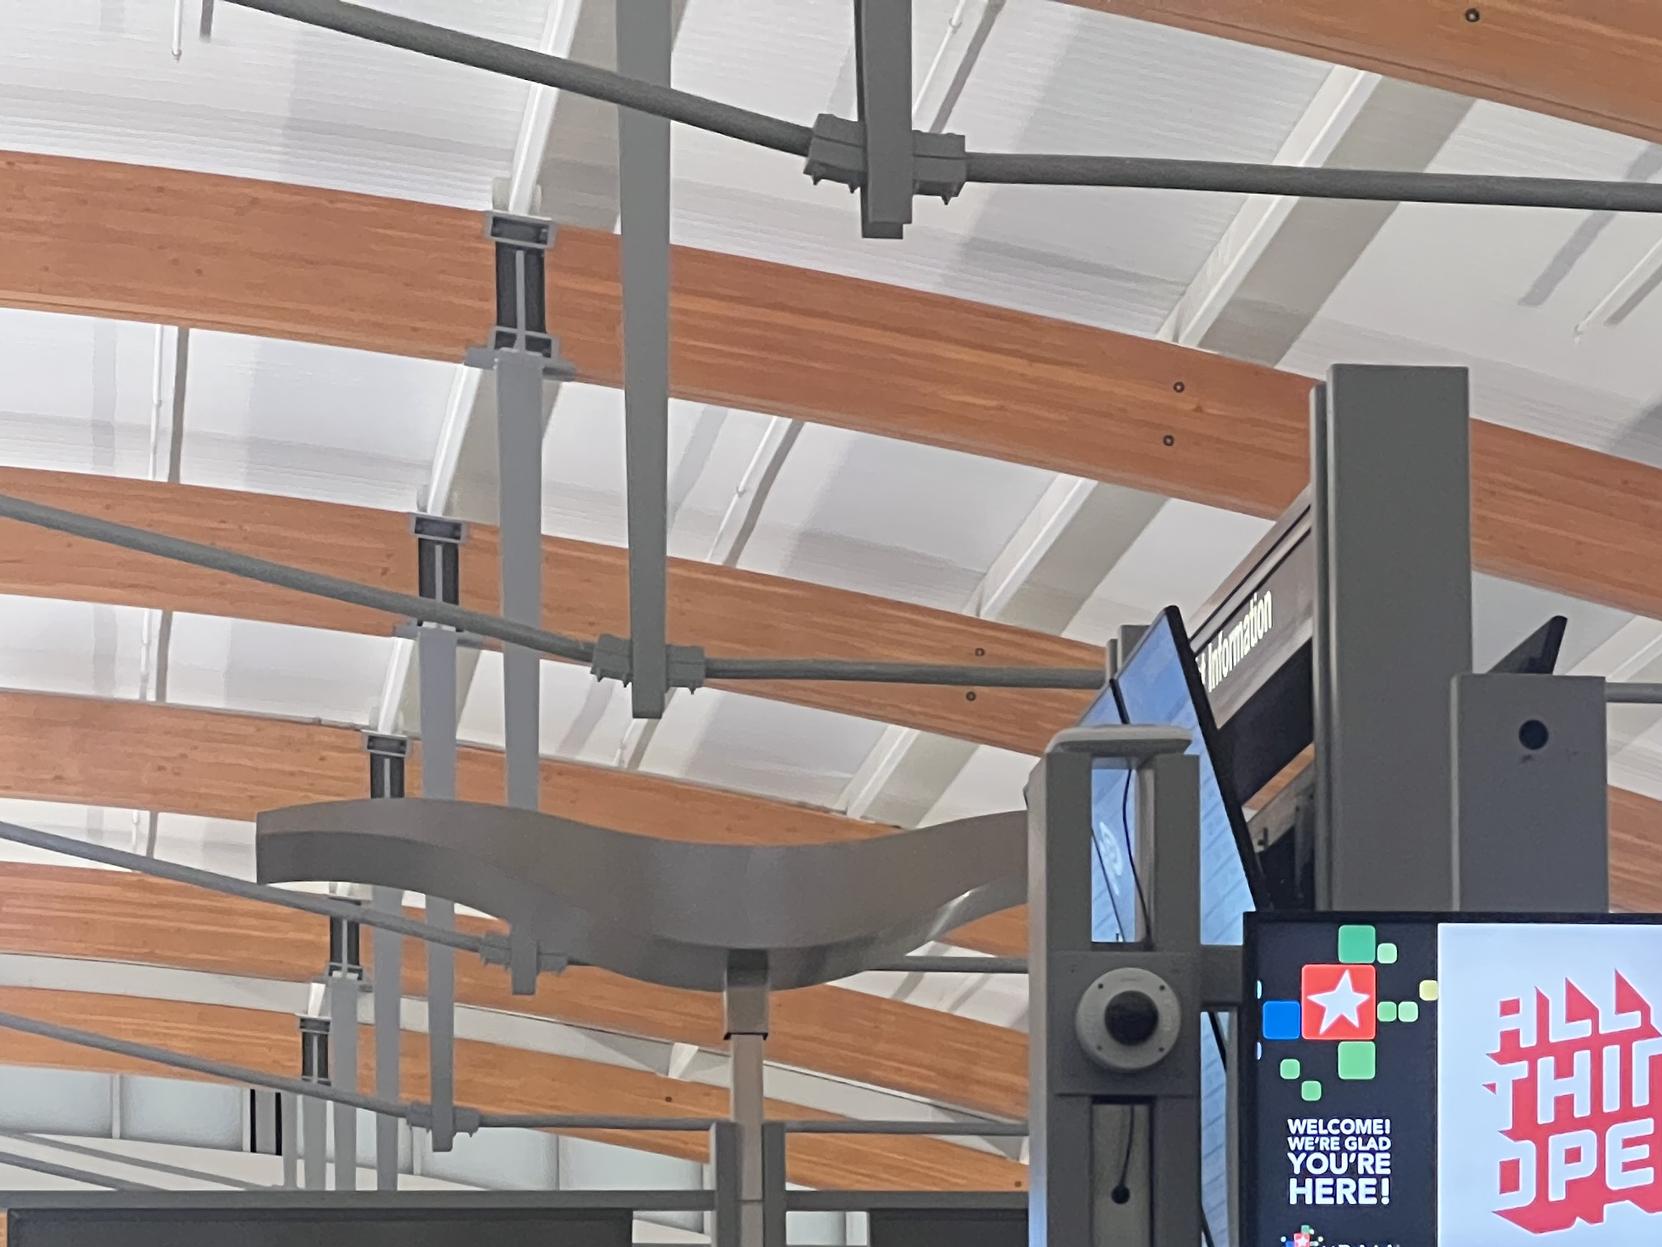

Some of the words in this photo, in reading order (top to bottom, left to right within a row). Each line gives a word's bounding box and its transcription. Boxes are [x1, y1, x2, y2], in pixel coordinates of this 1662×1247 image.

[1208, 590, 1273, 692] Information
[1483, 968, 1656, 1050] ALL
[1287, 1118, 1391, 1135] WELCOME!
[1287, 1136, 1341, 1151] WE'RE
[1344, 1136, 1392, 1151] GLAD
[1287, 1152, 1391, 1175] YOU'RE
[1289, 1177, 1390, 1205] HERE!
